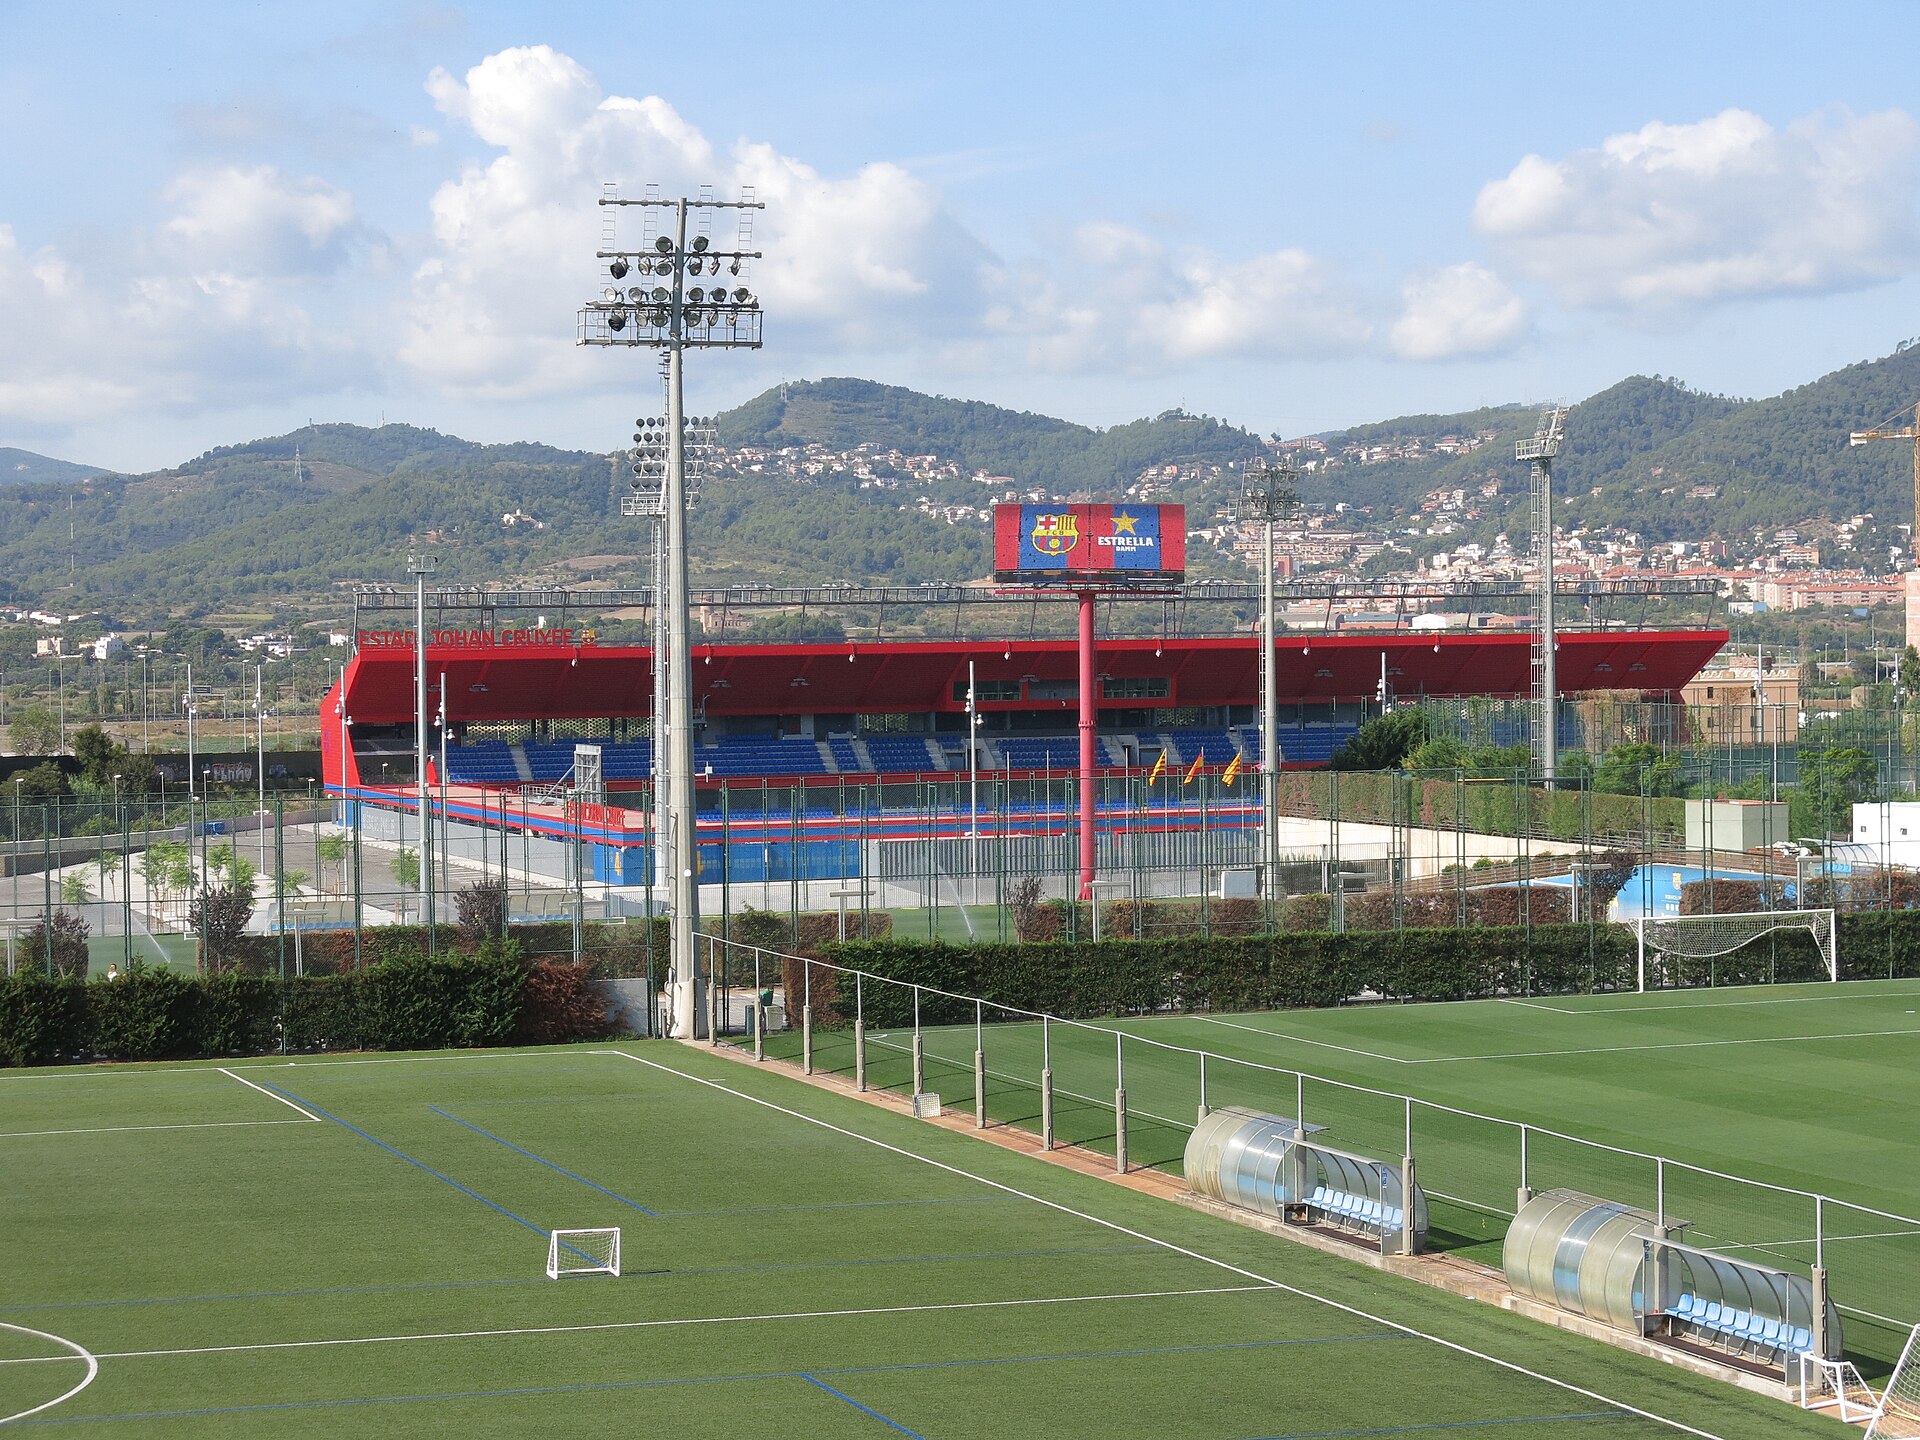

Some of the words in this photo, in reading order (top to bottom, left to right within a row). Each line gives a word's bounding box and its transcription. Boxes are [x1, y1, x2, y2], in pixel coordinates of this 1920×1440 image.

[1097, 536, 1154, 546] ESTRELLA
[358, 631, 418, 647] ESTAD
[431, 630, 494, 646] JOHAN
[501, 629, 574, 646] CRUYFF
